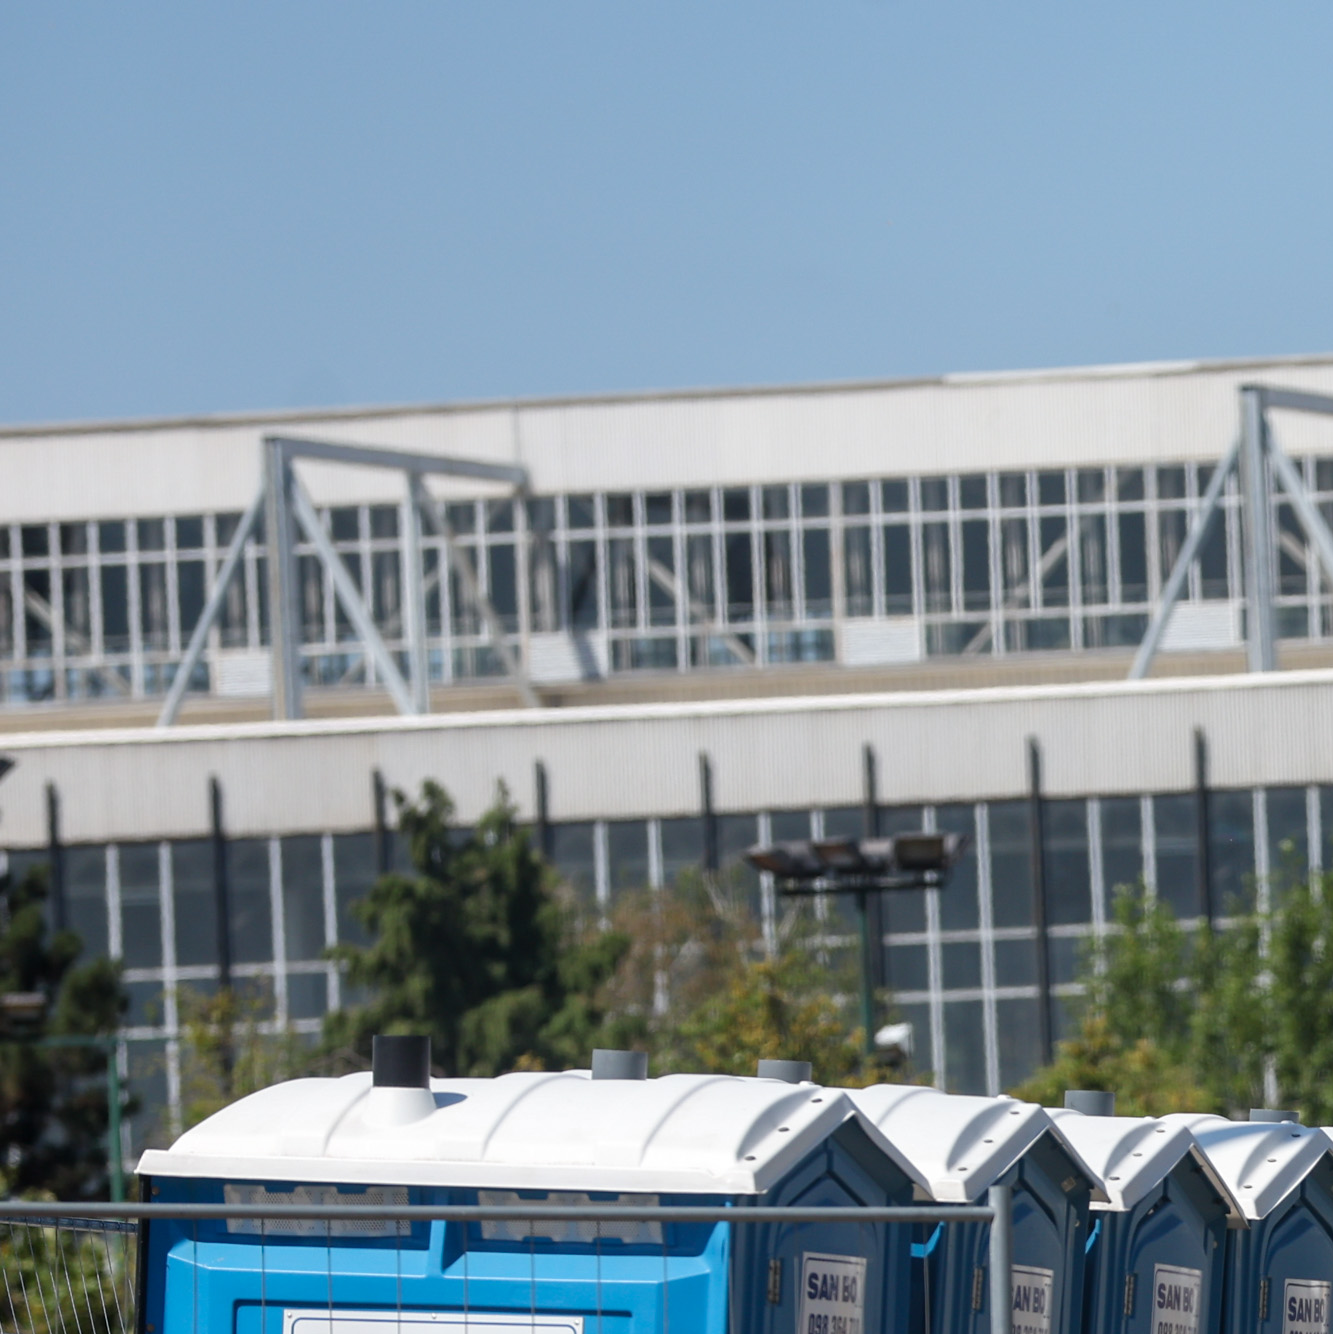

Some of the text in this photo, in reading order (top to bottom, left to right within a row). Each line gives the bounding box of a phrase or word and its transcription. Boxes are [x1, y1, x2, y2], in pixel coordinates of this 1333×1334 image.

[807, 1272, 861, 1306] SAN BO
[1011, 1285, 1031, 1312] AN
[1157, 1283, 1181, 1310] SAN
[1288, 1297, 1311, 1322] SAN
